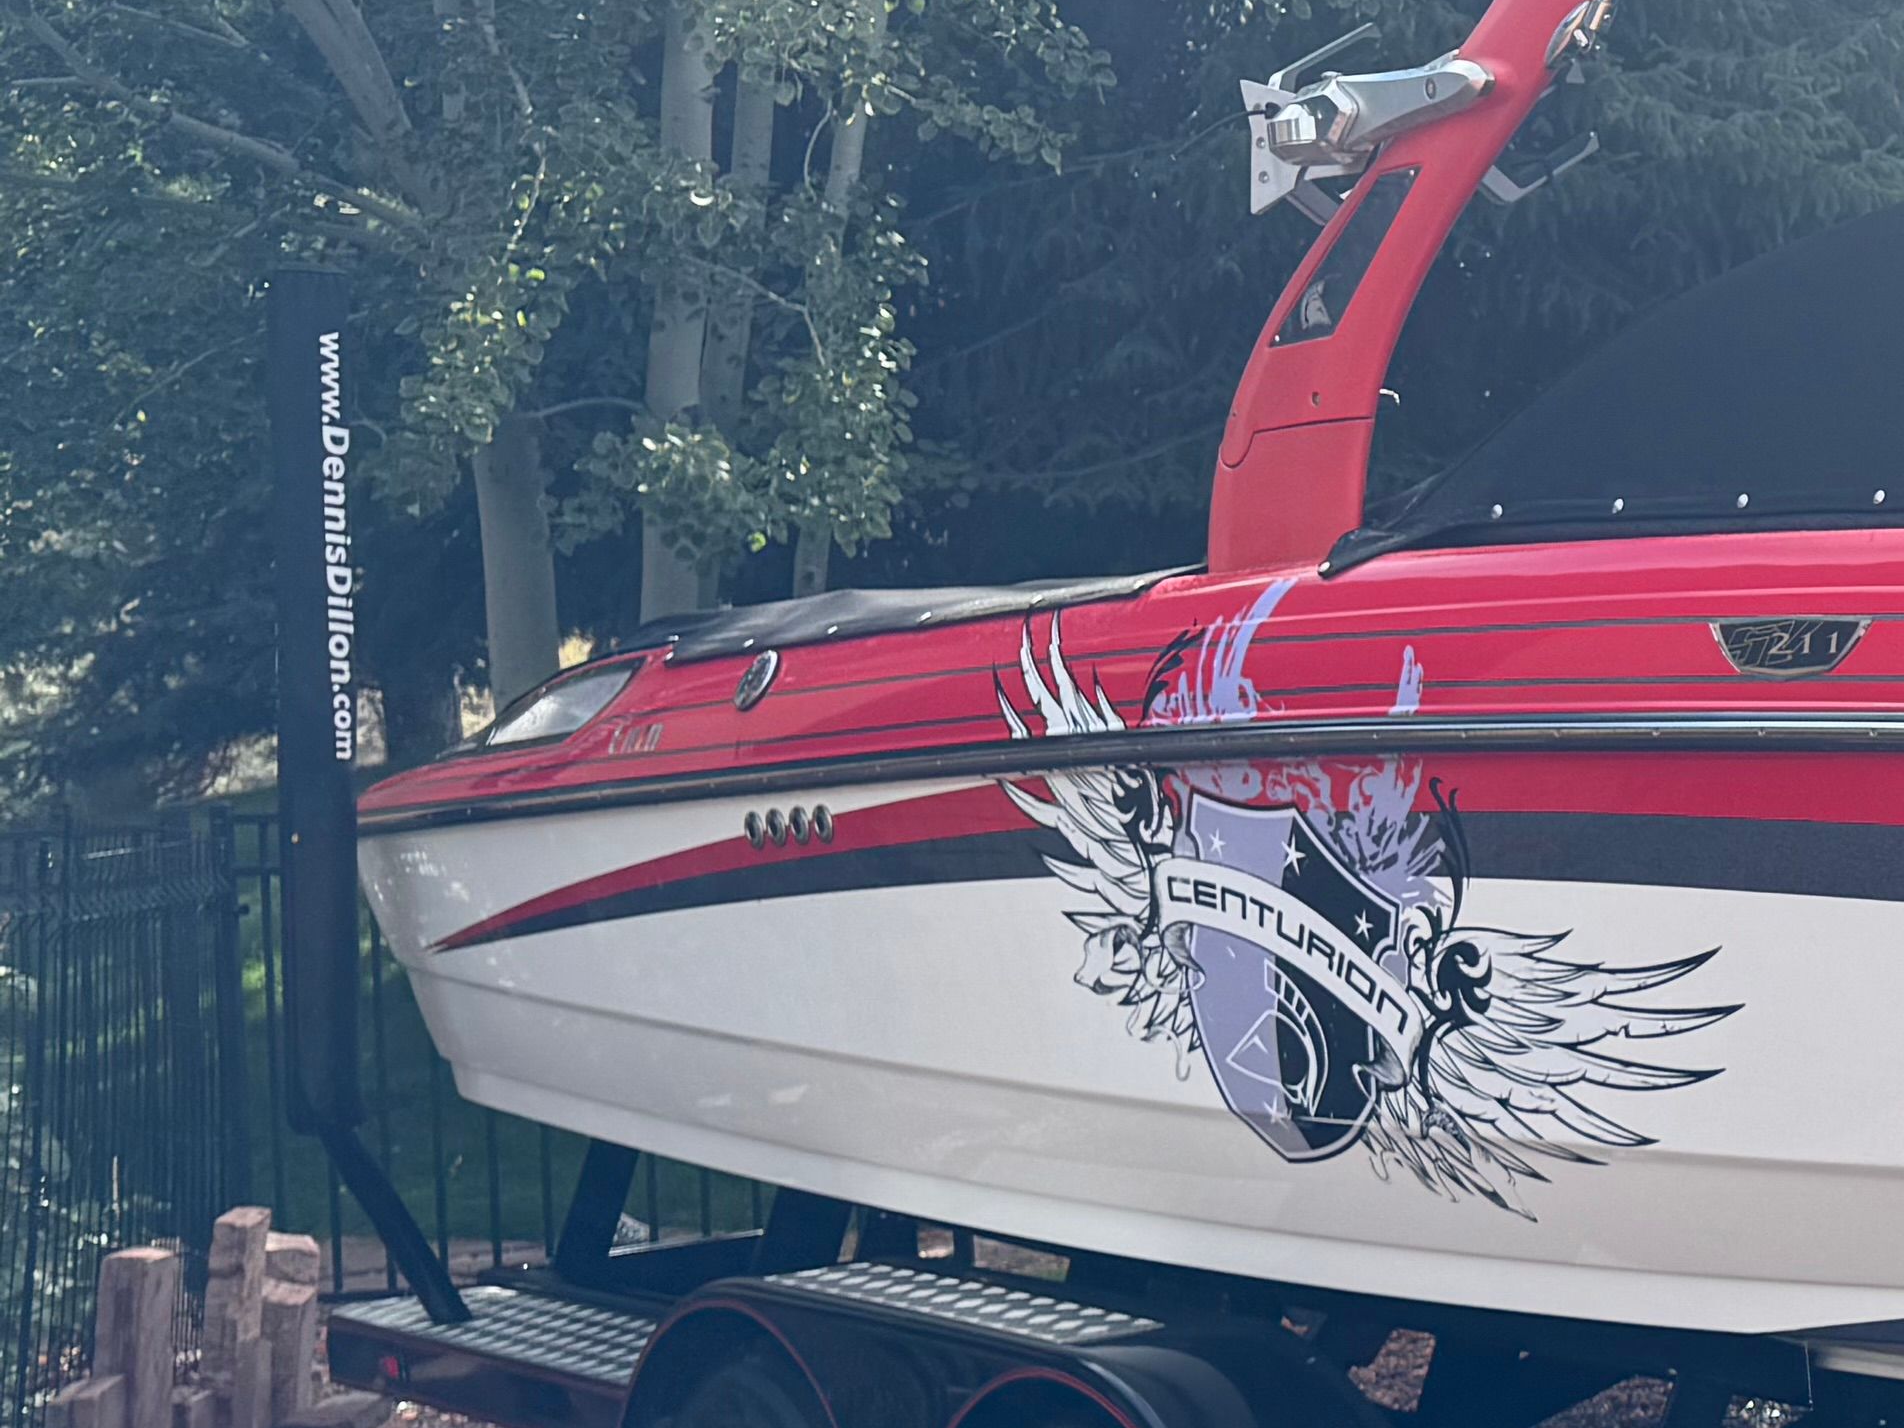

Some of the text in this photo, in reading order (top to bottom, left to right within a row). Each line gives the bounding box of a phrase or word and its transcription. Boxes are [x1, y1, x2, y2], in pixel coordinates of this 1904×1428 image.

[319, 331, 355, 761] www.DennisDillon.com
[1768, 631, 1839, 654] 211
[1167, 875, 1409, 1035] CENTURION
